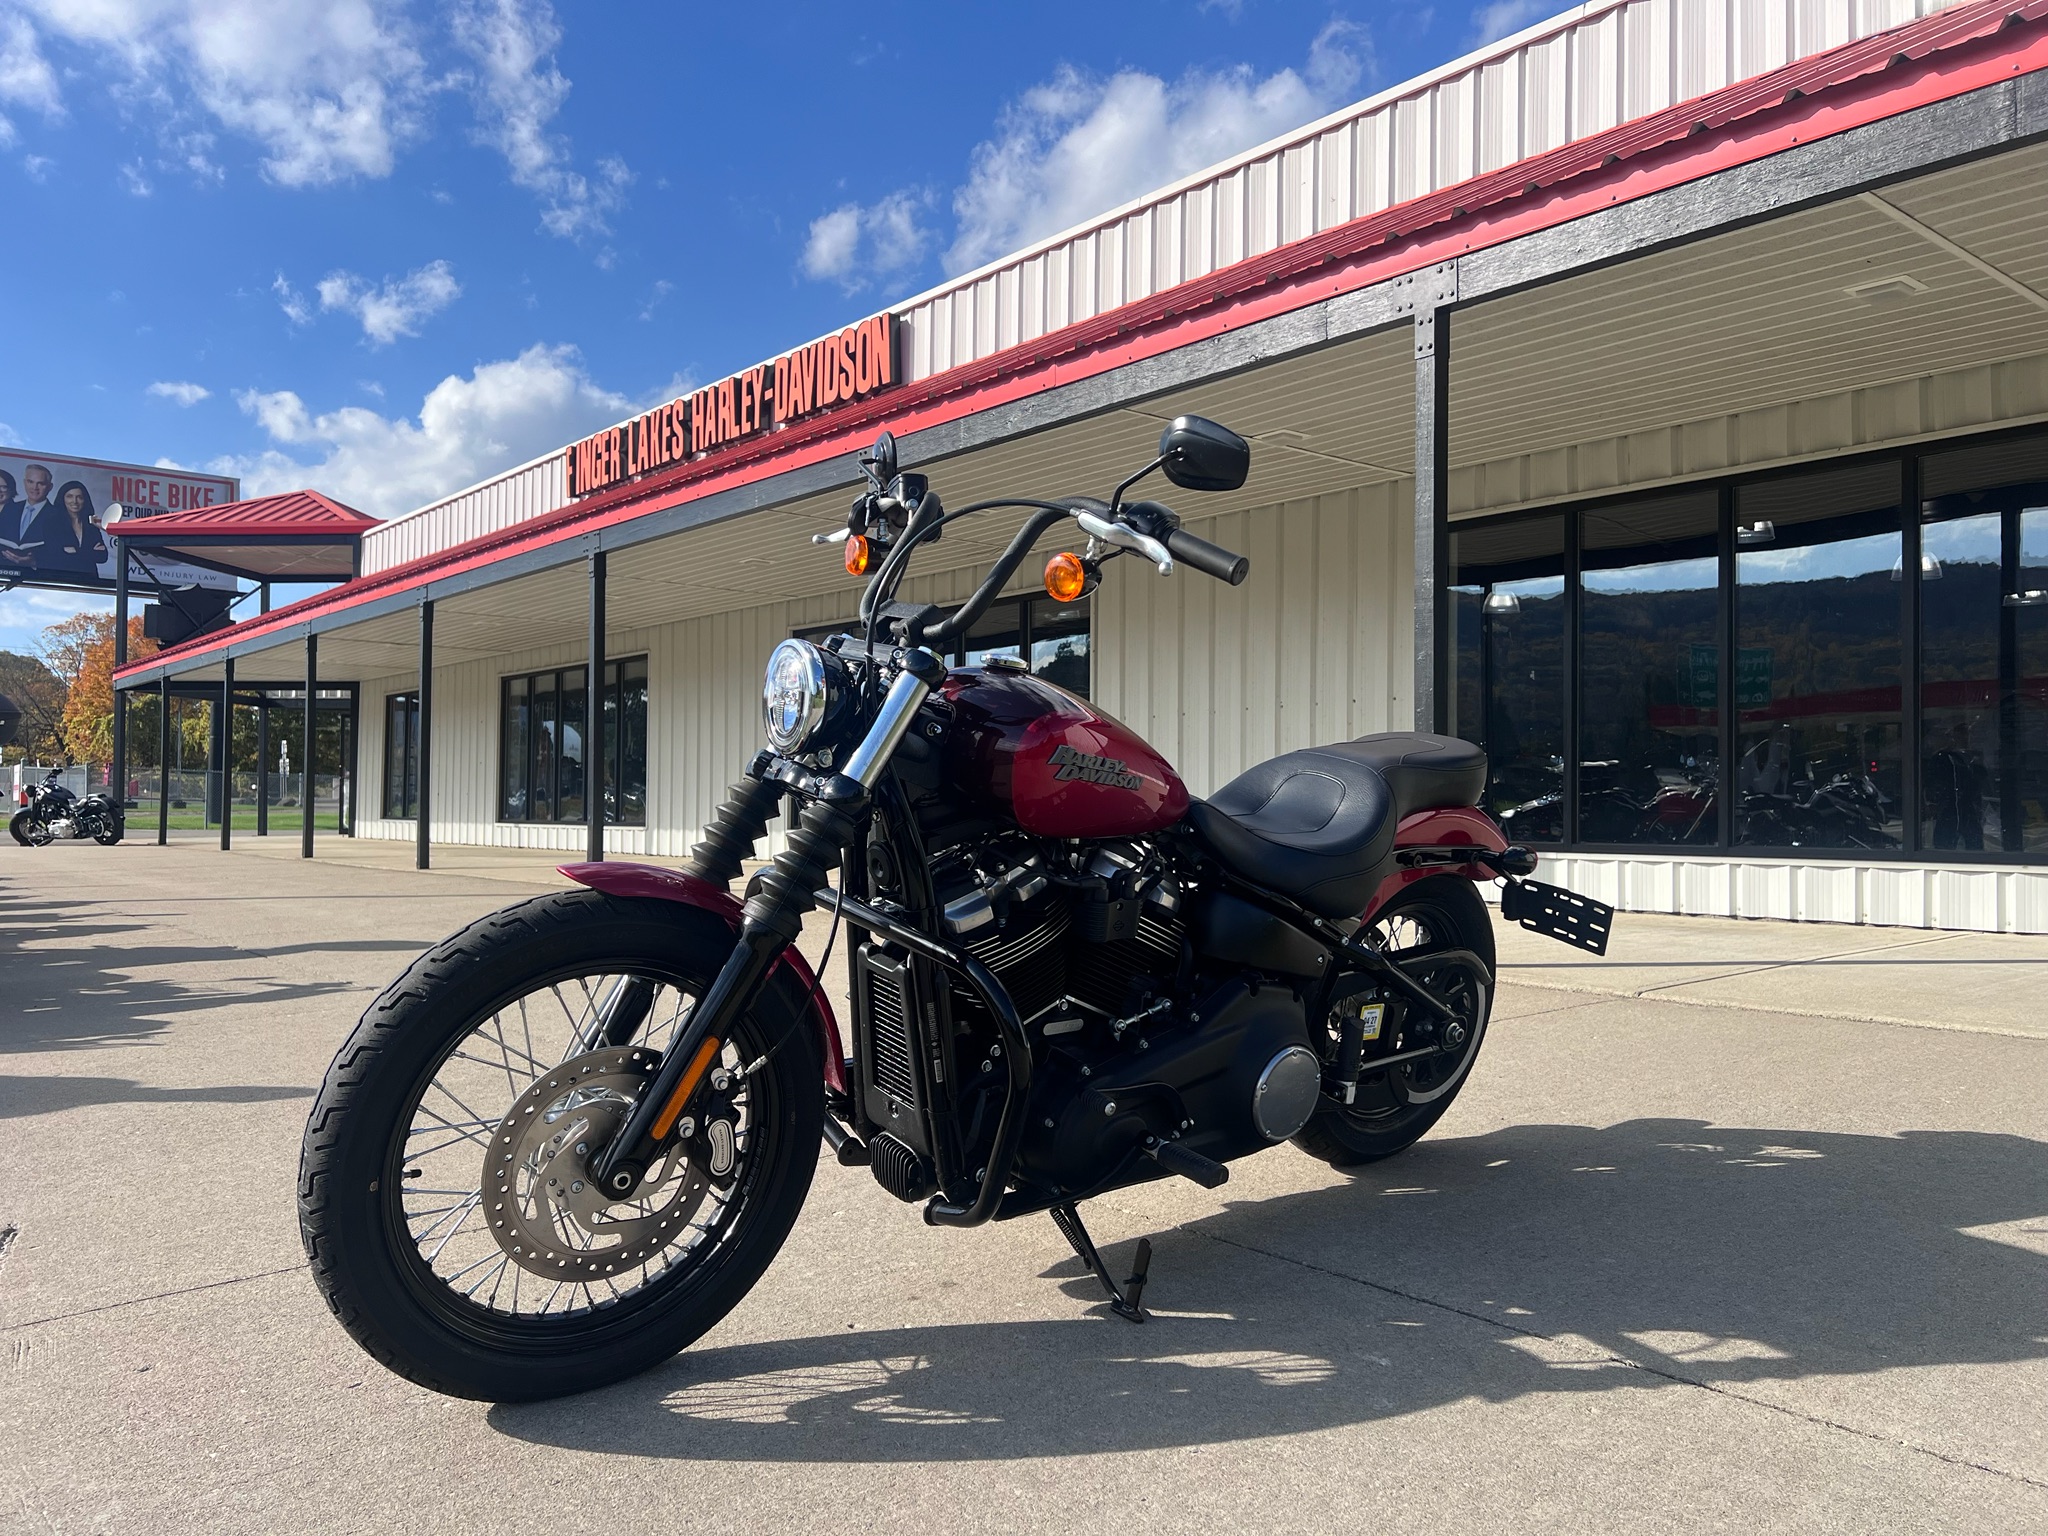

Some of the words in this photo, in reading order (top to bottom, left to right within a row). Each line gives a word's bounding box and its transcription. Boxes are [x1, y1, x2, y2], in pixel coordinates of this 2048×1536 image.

[566, 427, 621, 498] FINGER
[628, 399, 684, 476] LAKES
[691, 313, 890, 452] HARLEY-DAVIDSON
[112, 476, 160, 506] NICE
[168, 483, 215, 510] BIKE
[160, 571, 194, 579] INJURY
[1054, 765, 1144, 790] DAVIDSON
